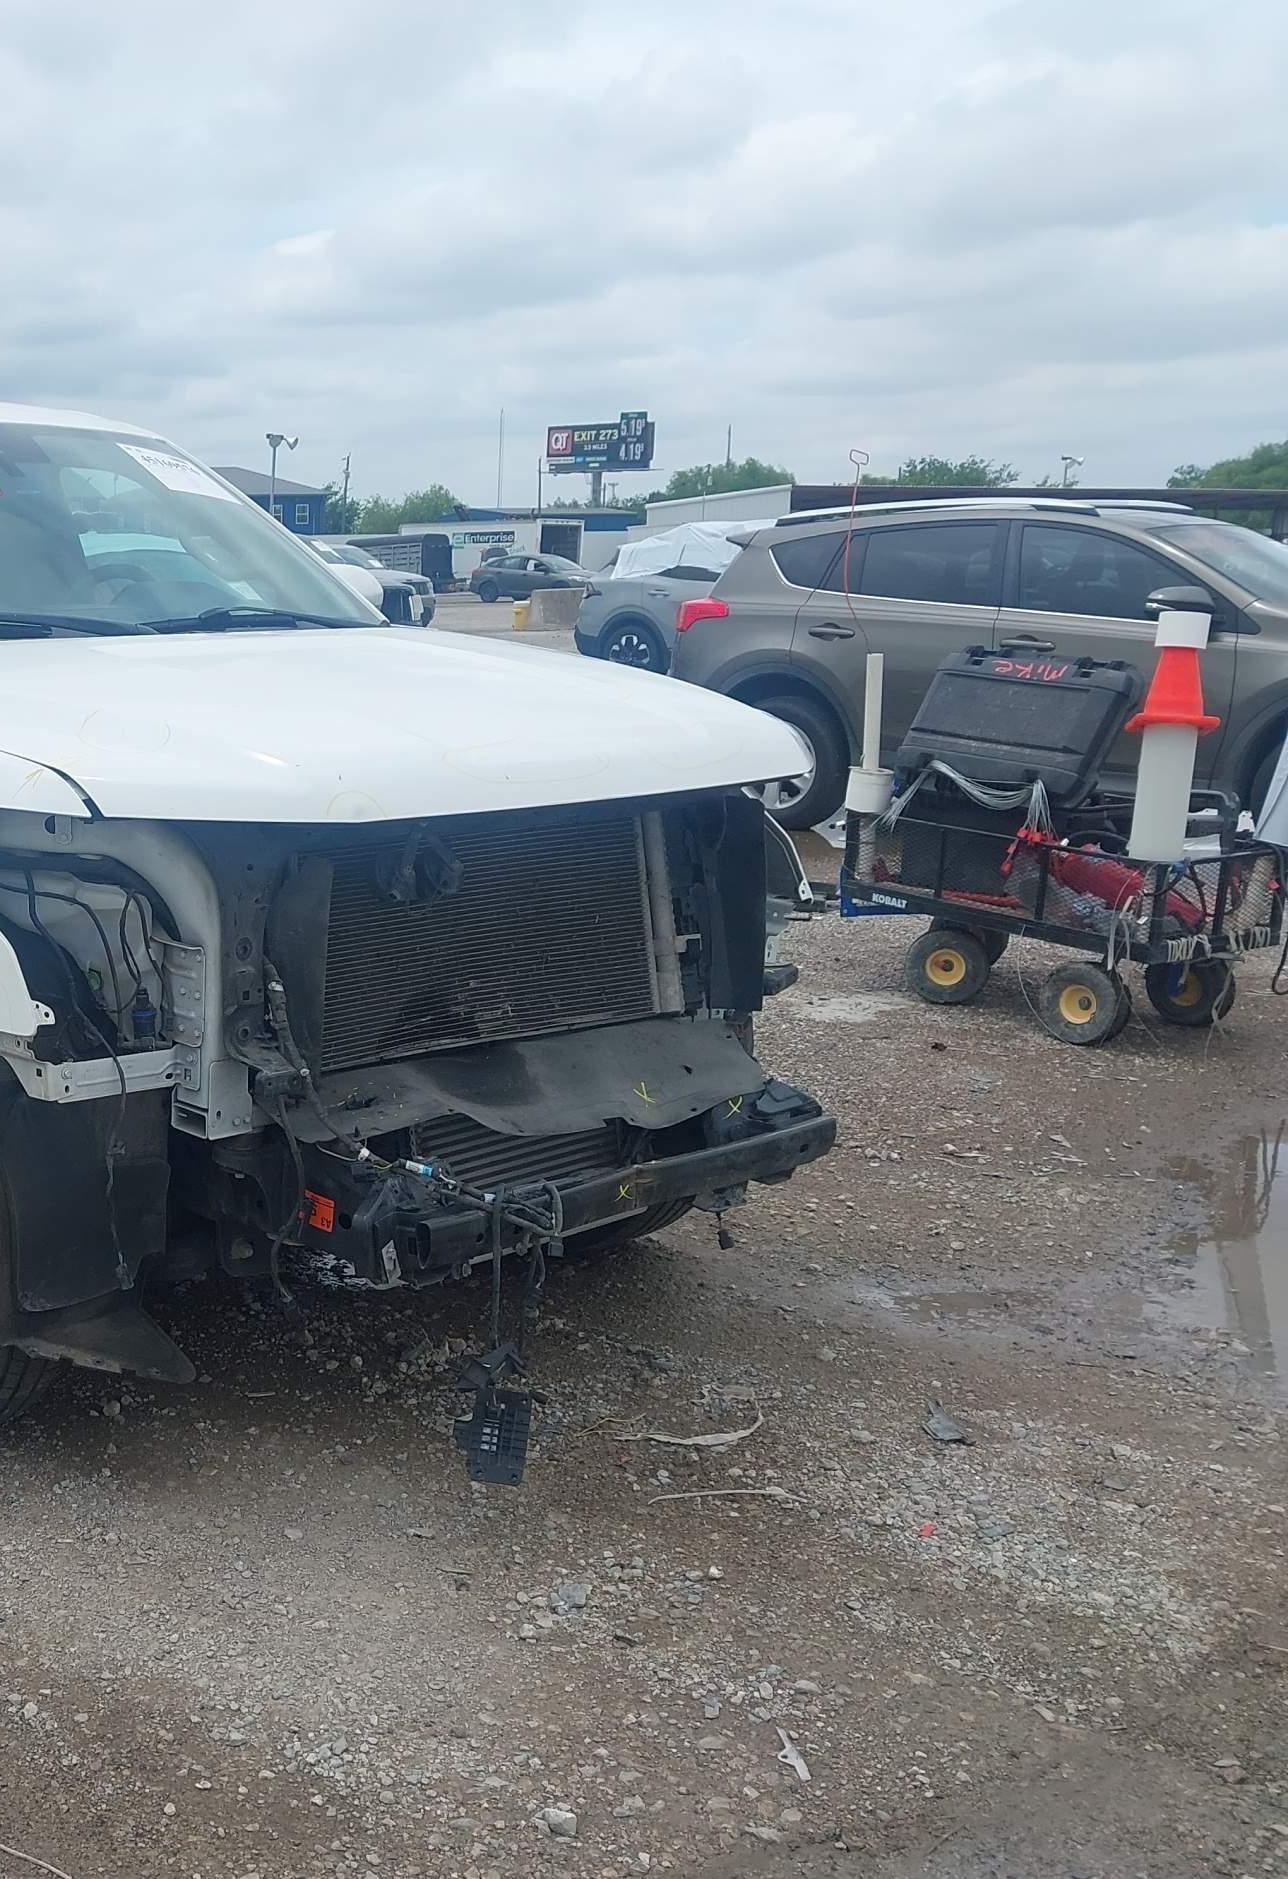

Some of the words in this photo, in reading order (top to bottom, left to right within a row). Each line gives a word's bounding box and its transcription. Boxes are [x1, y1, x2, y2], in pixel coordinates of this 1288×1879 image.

[552, 433, 569, 452] QT
[574, 431, 597, 442] EXIT
[599, 429, 619, 441] 273
[465, 533, 514, 544] Enterprise
[872, 892, 908, 909] KOBALT
